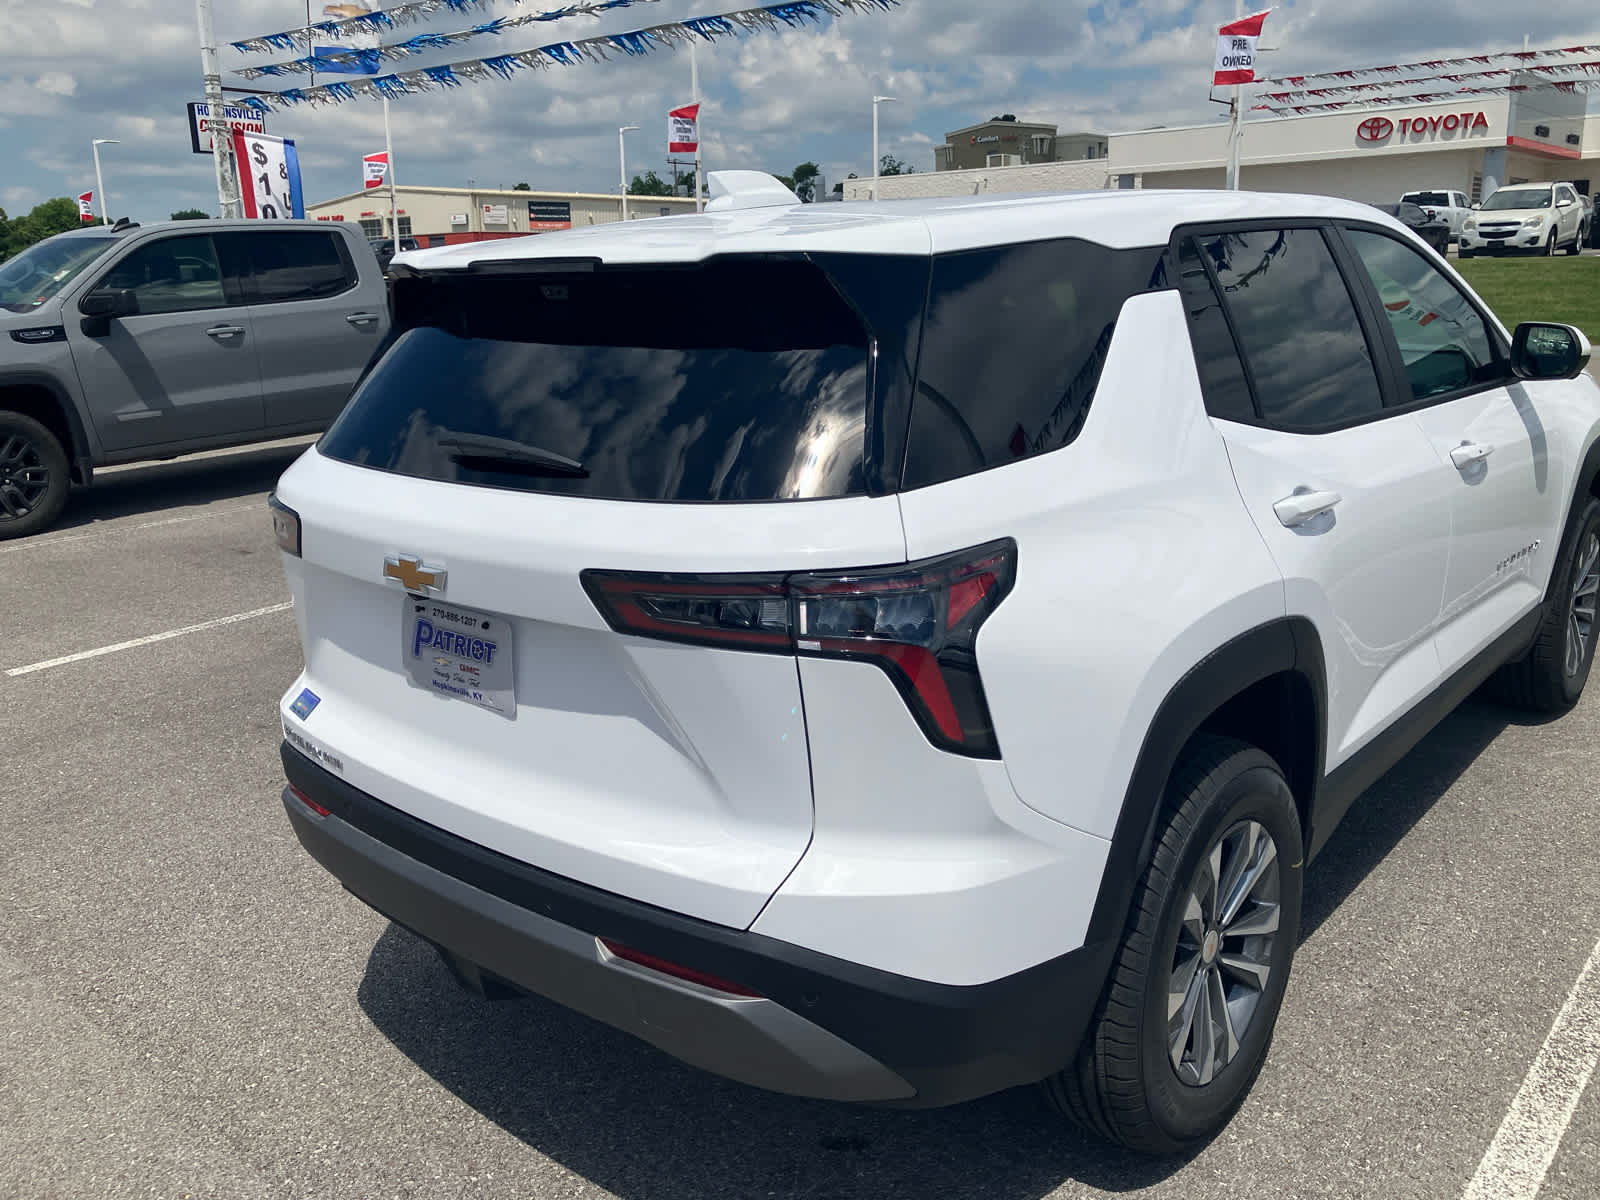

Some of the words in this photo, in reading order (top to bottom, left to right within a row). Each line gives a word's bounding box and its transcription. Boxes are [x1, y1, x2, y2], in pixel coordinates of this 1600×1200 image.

[1232, 39, 1248, 51] PRE
[1222, 55, 1252, 67] OWNED
[197, 105, 261, 120] HONSVILLE
[1399, 112, 1489, 136] TOYOTA
[414, 619, 497, 664] PATRIOT
[459, 663, 480, 677] GMC
